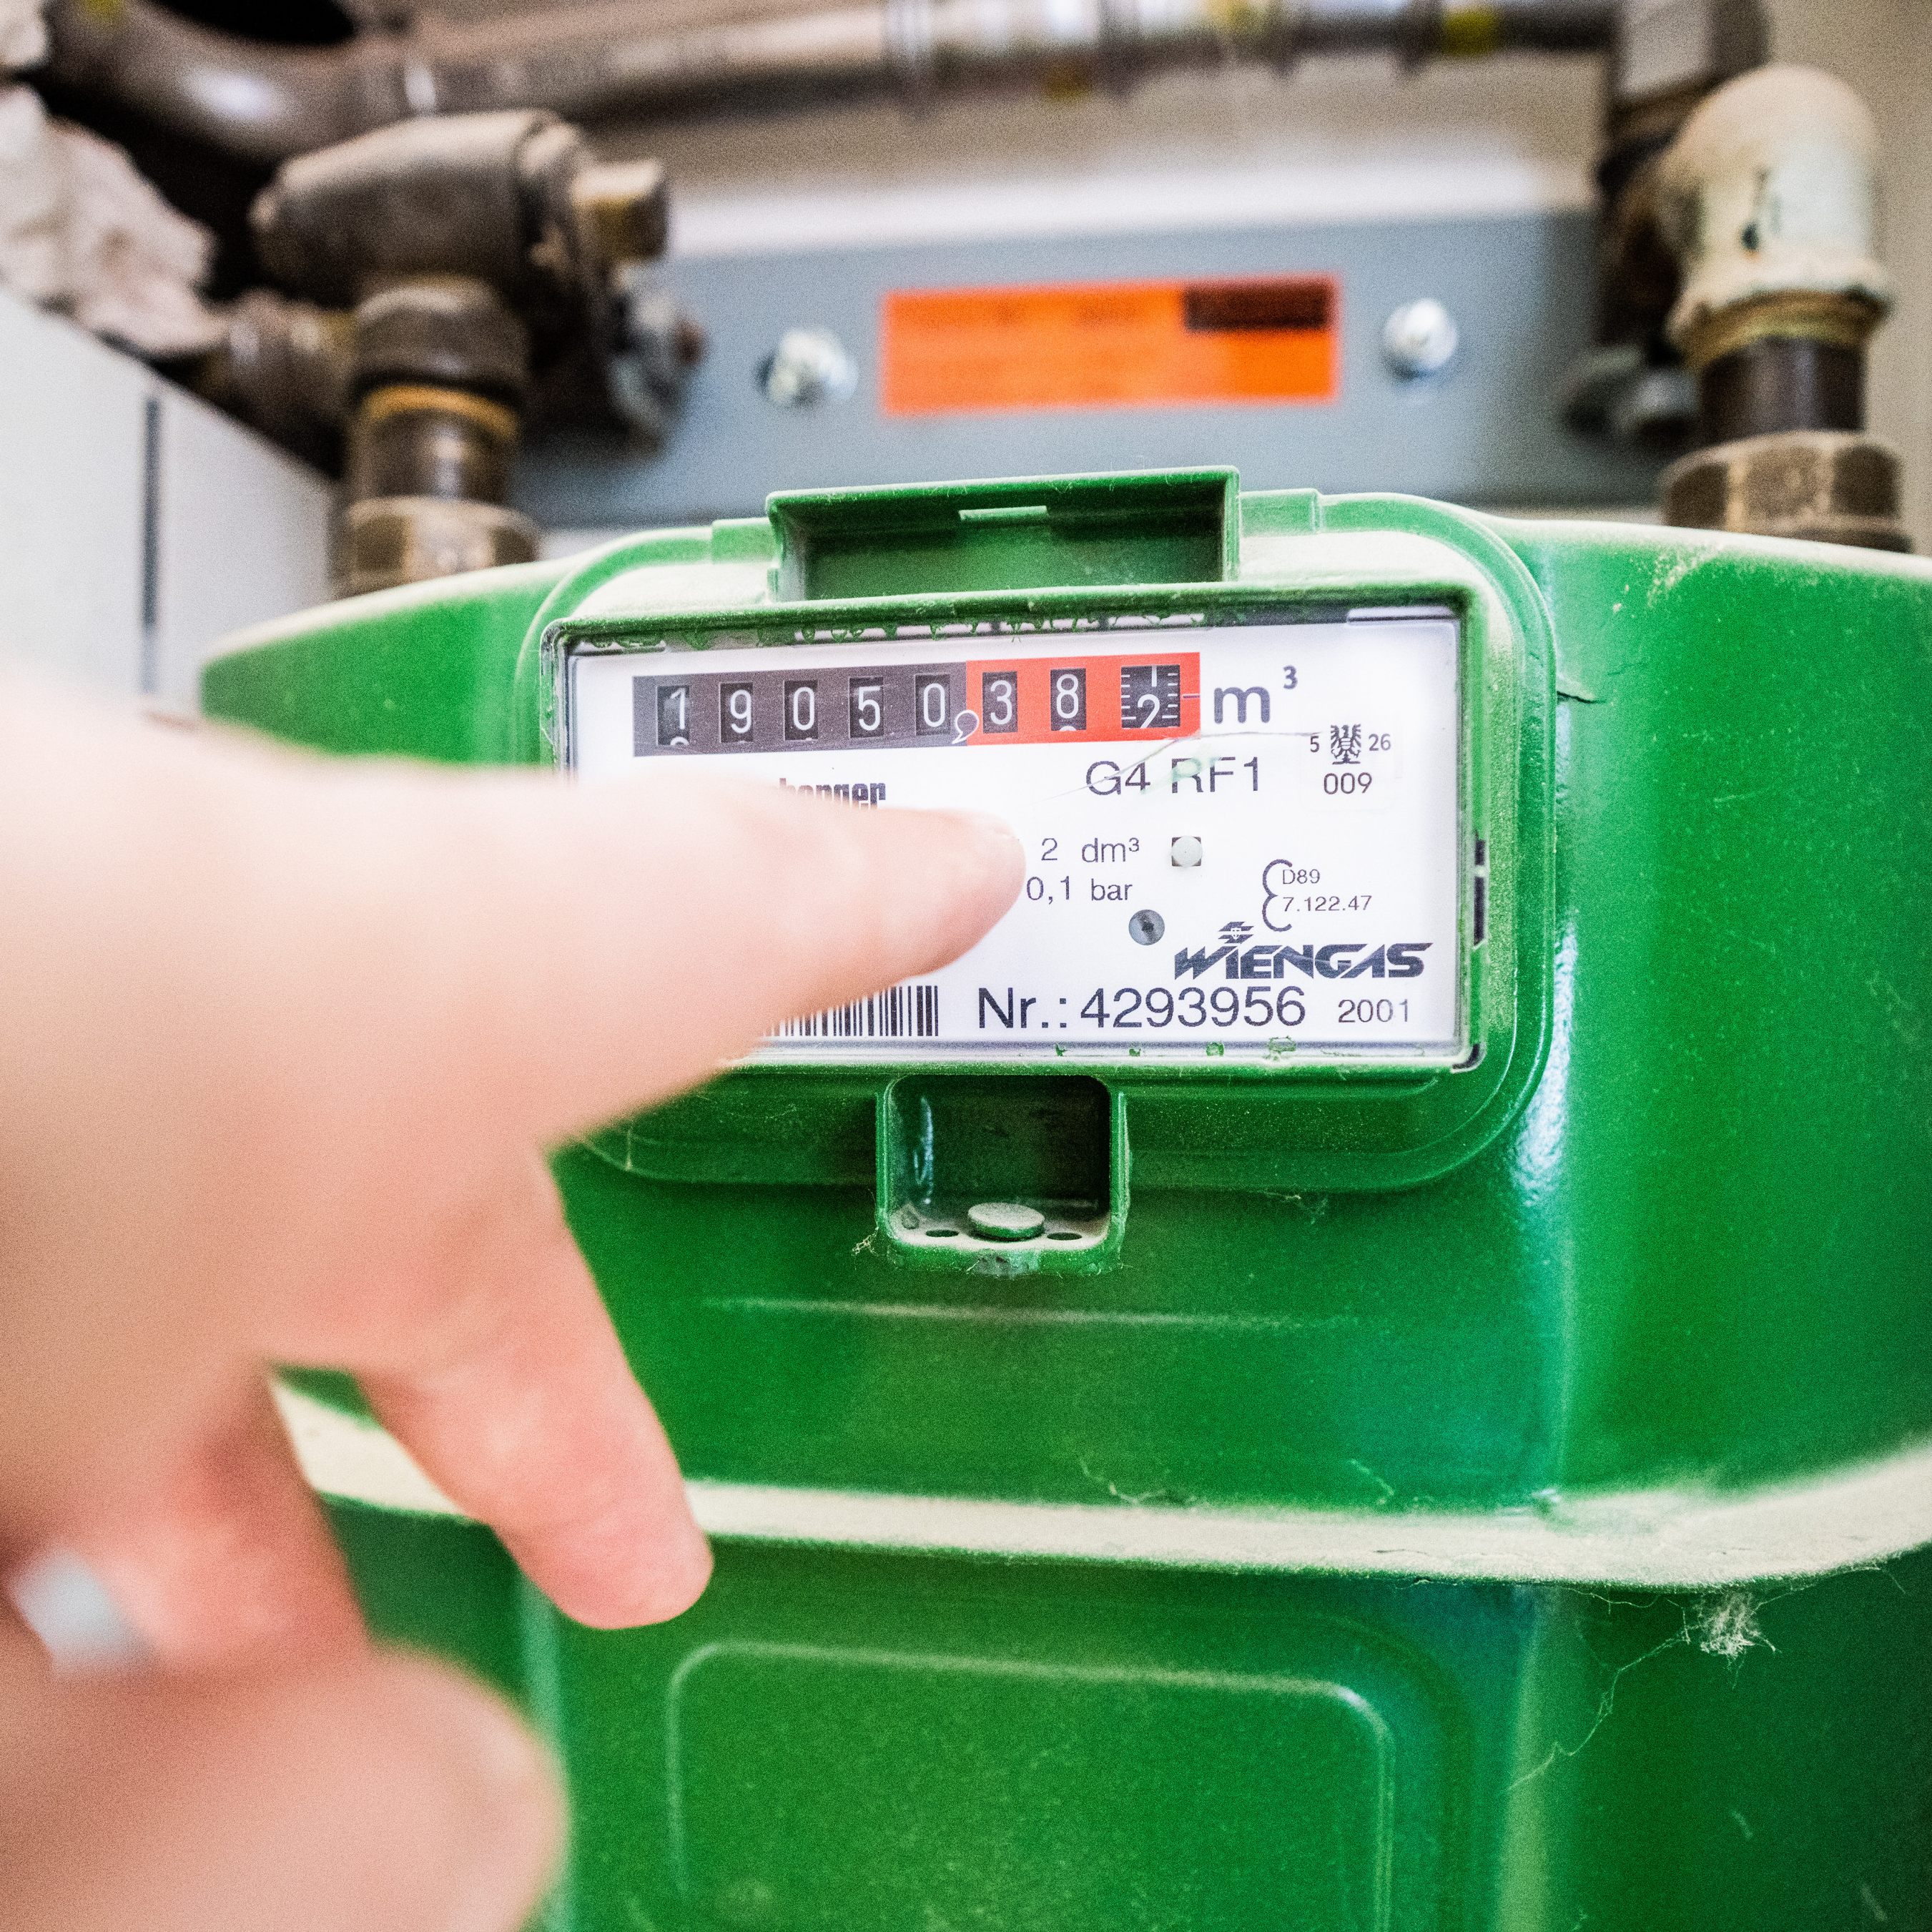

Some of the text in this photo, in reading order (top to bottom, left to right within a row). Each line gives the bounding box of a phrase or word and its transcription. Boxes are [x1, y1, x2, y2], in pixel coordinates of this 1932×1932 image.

[1309, 733, 1391, 753] 5 26
[1085, 756, 1258, 796] G4 RF1
[1324, 772, 1373, 795] 009
[1041, 837, 1058, 861] 2
[1282, 869, 1321, 884] D89
[1026, 875, 1133, 905] 0,1 bar
[1283, 895, 1373, 912] 7.122.47
[1338, 999, 1409, 1023] 2001
